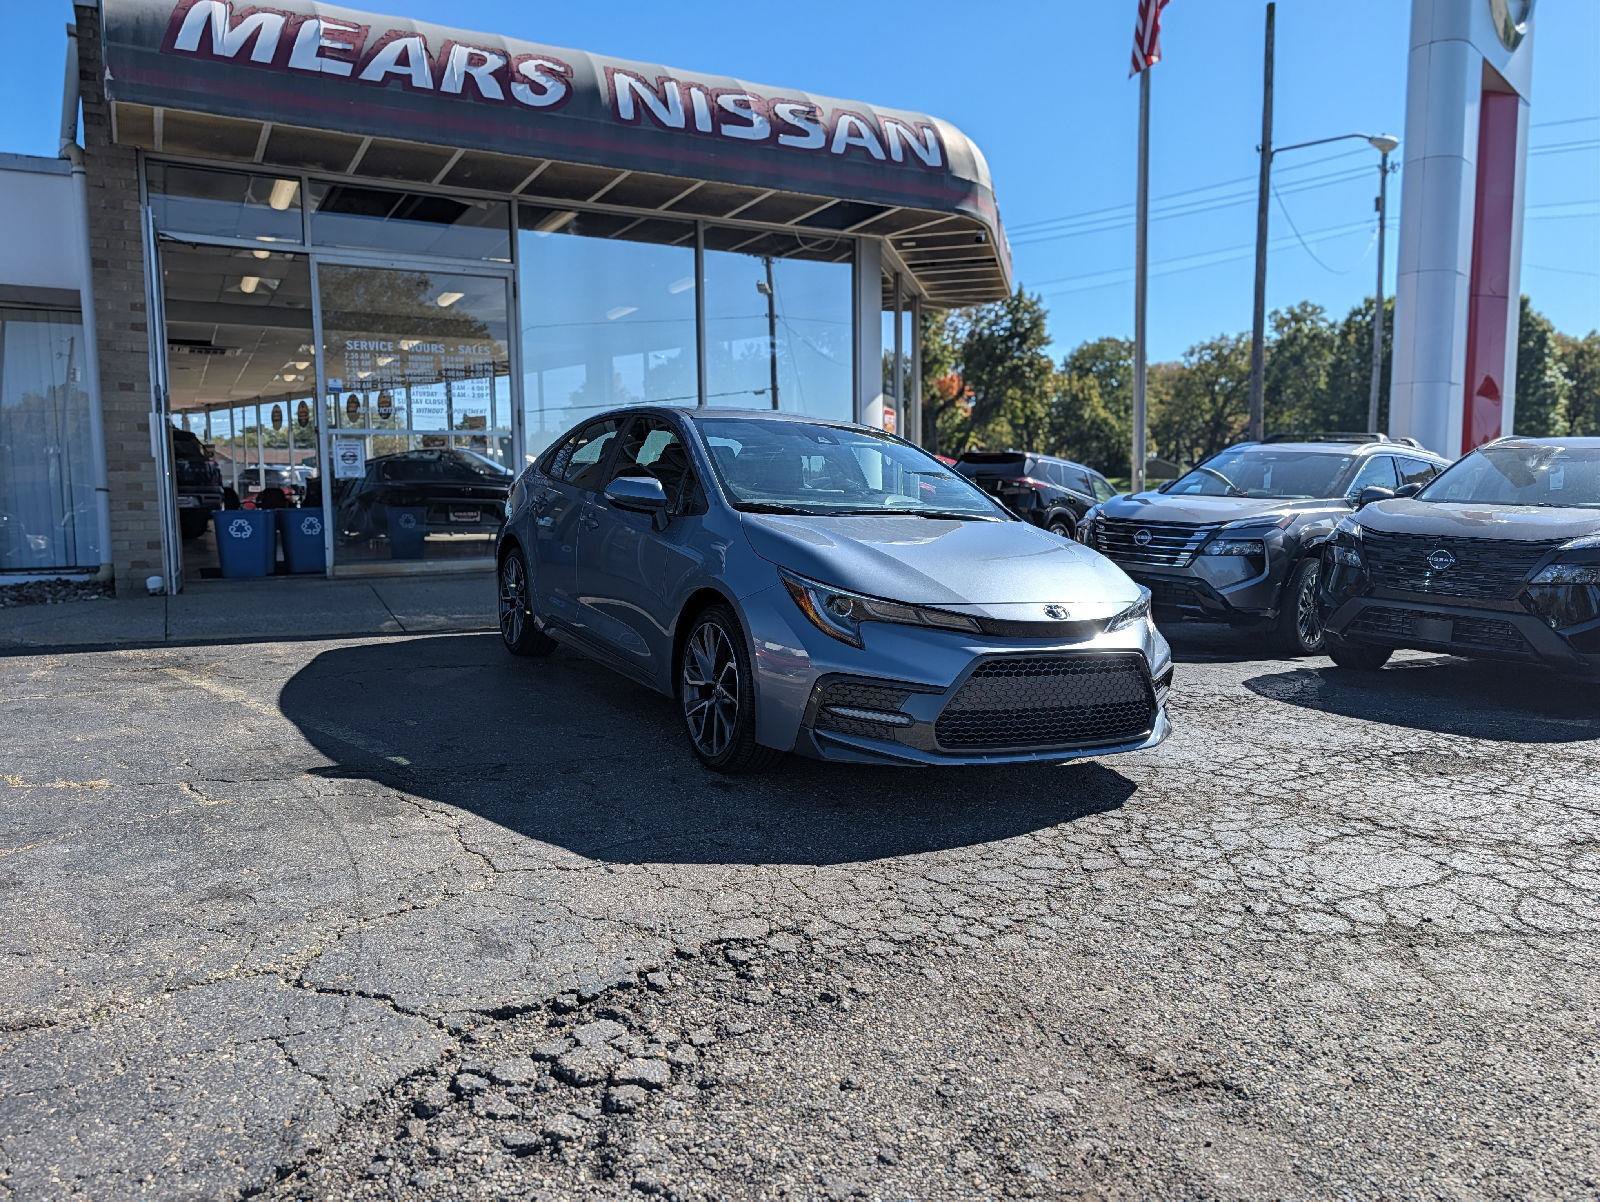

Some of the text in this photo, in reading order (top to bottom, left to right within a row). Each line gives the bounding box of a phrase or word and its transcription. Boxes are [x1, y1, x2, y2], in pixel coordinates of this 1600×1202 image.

[174, 0, 943, 167] MEARS NISSAN
[345, 340, 394, 352] SERVICE
[458, 345, 490, 354] SALES
